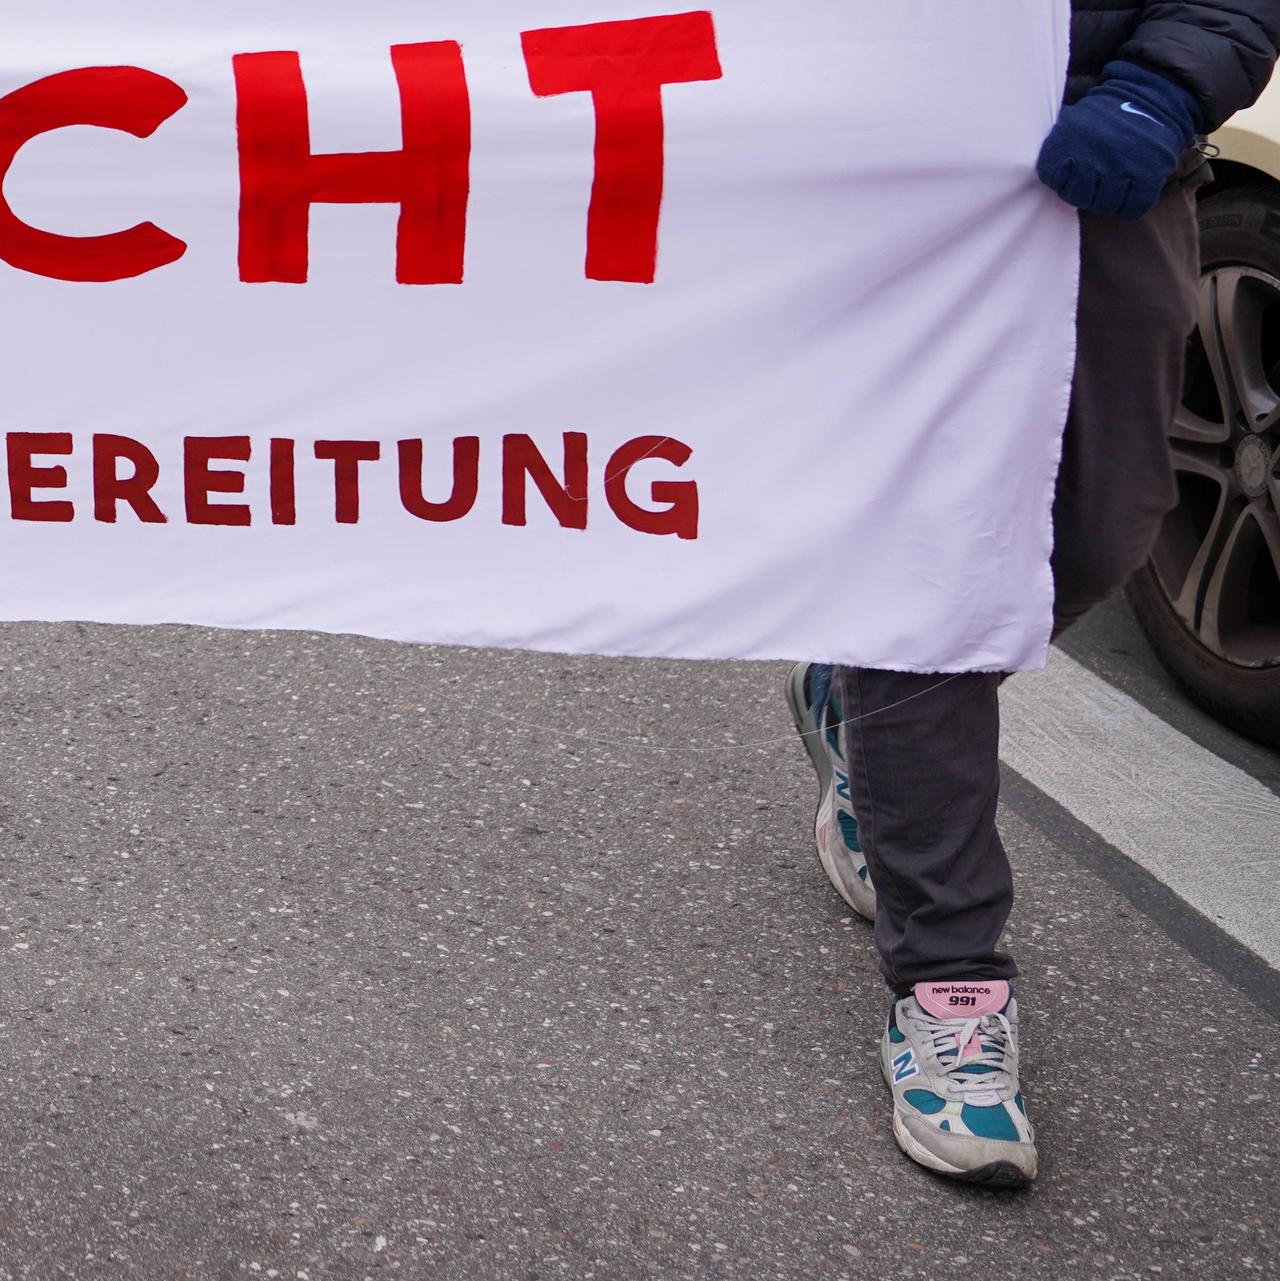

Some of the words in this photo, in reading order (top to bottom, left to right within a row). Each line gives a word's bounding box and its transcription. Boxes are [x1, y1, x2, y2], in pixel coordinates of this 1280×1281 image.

[931, 986, 951, 995] new
[951, 985, 991, 995] balance
[948, 996, 977, 1006] 991
